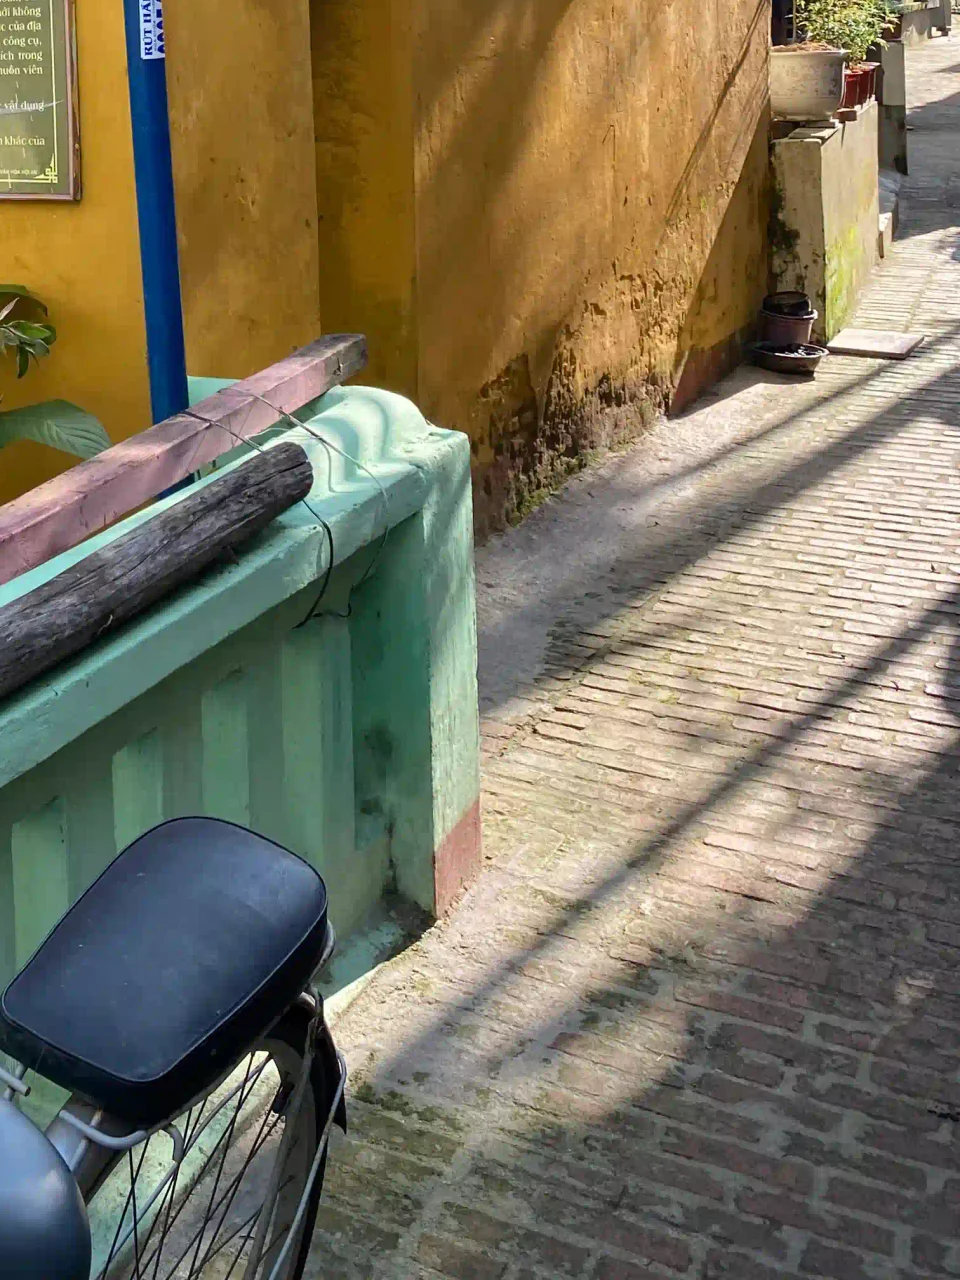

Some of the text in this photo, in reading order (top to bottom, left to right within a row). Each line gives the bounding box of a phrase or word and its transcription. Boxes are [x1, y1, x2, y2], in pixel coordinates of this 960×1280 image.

[12, 4, 41, 17] không
[8, 22, 24, 30] của
[27, 21, 41, 32] địa
[3, 35, 26, 46] công
[28, 35, 42, 46] cụ,
[18, 50, 42, 61] trong
[23, 63, 43, 74] viên
[21, 101, 45, 111] dụng
[5, 135, 26, 146] khác
[28, 135, 45, 146] của
